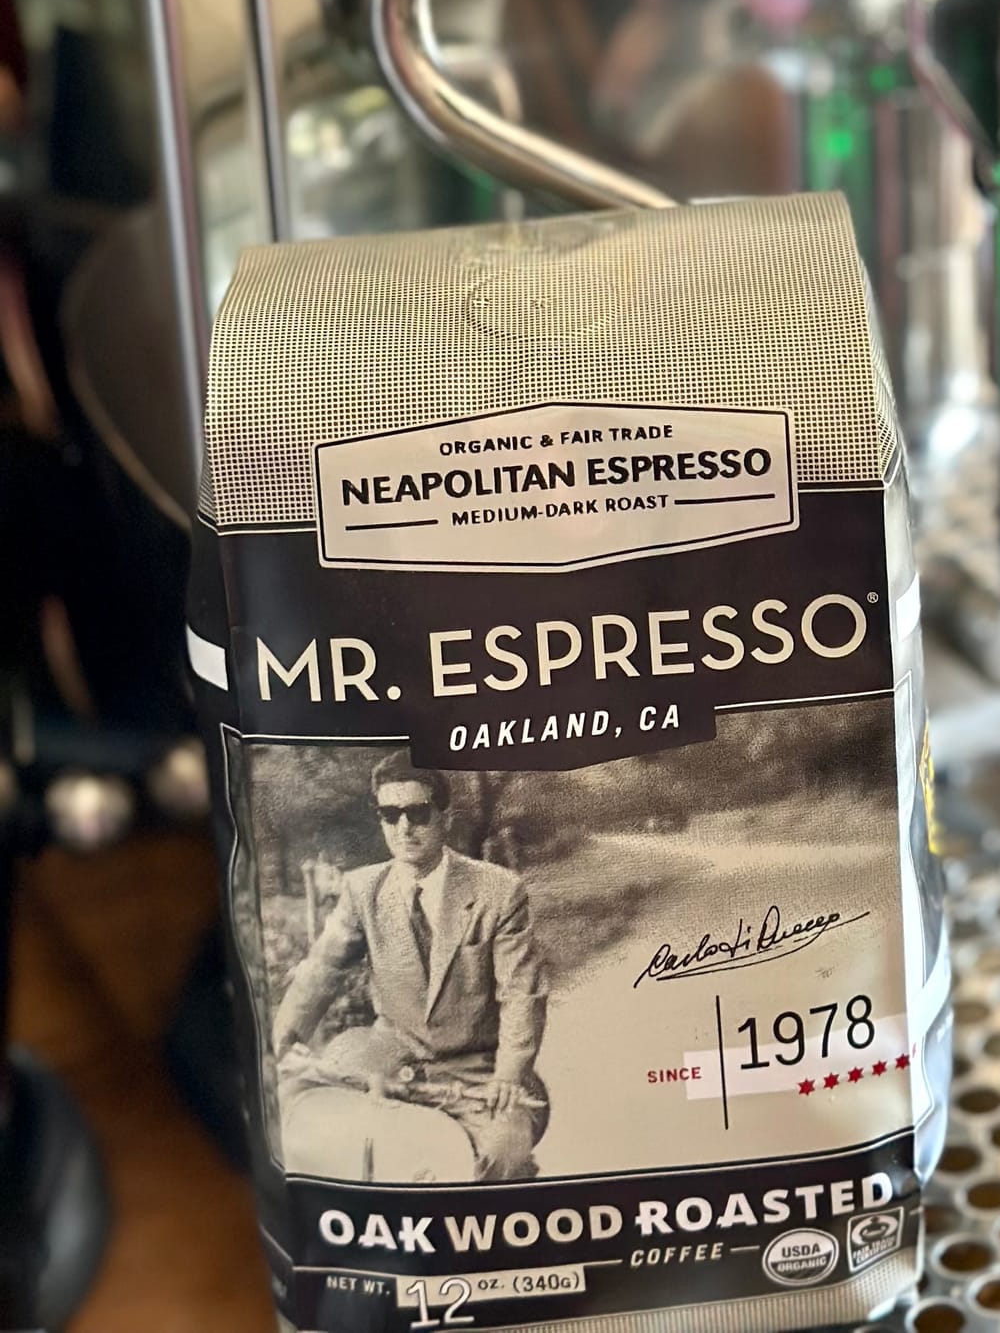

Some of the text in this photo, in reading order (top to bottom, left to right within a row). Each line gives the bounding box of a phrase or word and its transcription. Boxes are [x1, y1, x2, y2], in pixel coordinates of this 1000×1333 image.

[439, 424, 674, 456] ORGANIC & FAIR TRADE
[342, 448, 772, 506] NEAPOLITAN ESPRESSO
[452, 494, 669, 527] MEDIUM-DARK ROAST
[256, 636, 402, 703] MR.
[449, 704, 680, 752] OAKLAND, CA
[737, 993, 876, 1071] 1978
[646, 1066, 703, 1084] SINCE
[318, 1171, 894, 1254] OAK WOOD ROASTED
[630, 1242, 725, 1268] COFFEE
[777, 1256, 827, 1272] ORGANIC
[782, 1243, 821, 1258] USDA
[326, 1274, 357, 1291] NET
[363, 1279, 390, 1296] WT.
[405, 1276, 475, 1329] 12
